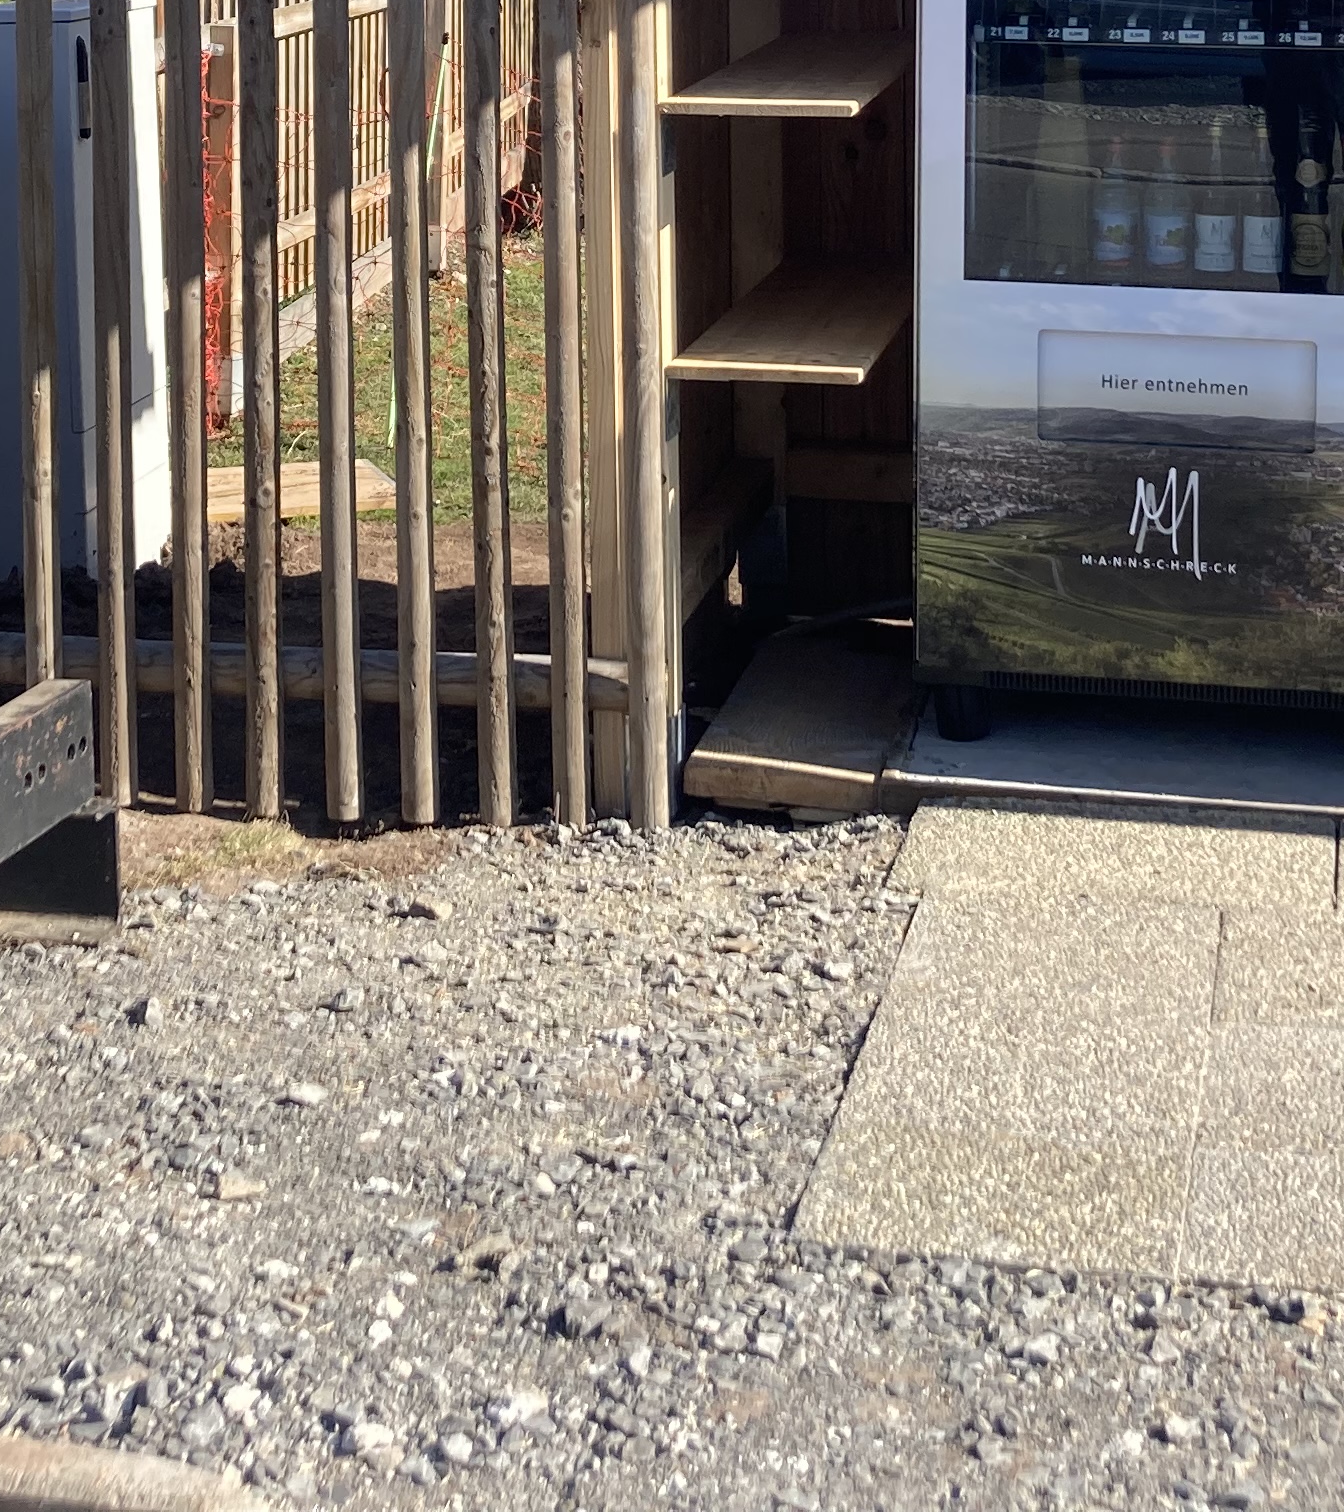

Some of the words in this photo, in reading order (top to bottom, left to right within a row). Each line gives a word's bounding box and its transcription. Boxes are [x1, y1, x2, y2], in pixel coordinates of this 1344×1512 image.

[990, 27, 1002, 36] 21
[1047, 28, 1060, 38] 22
[1109, 29, 1122, 39] 23
[1162, 31, 1175, 40] 24
[1222, 32, 1235, 42] 25
[1278, 33, 1291, 43] 26
[1101, 374, 1138, 390] Hier
[1144, 378, 1249, 396] entnehmen
